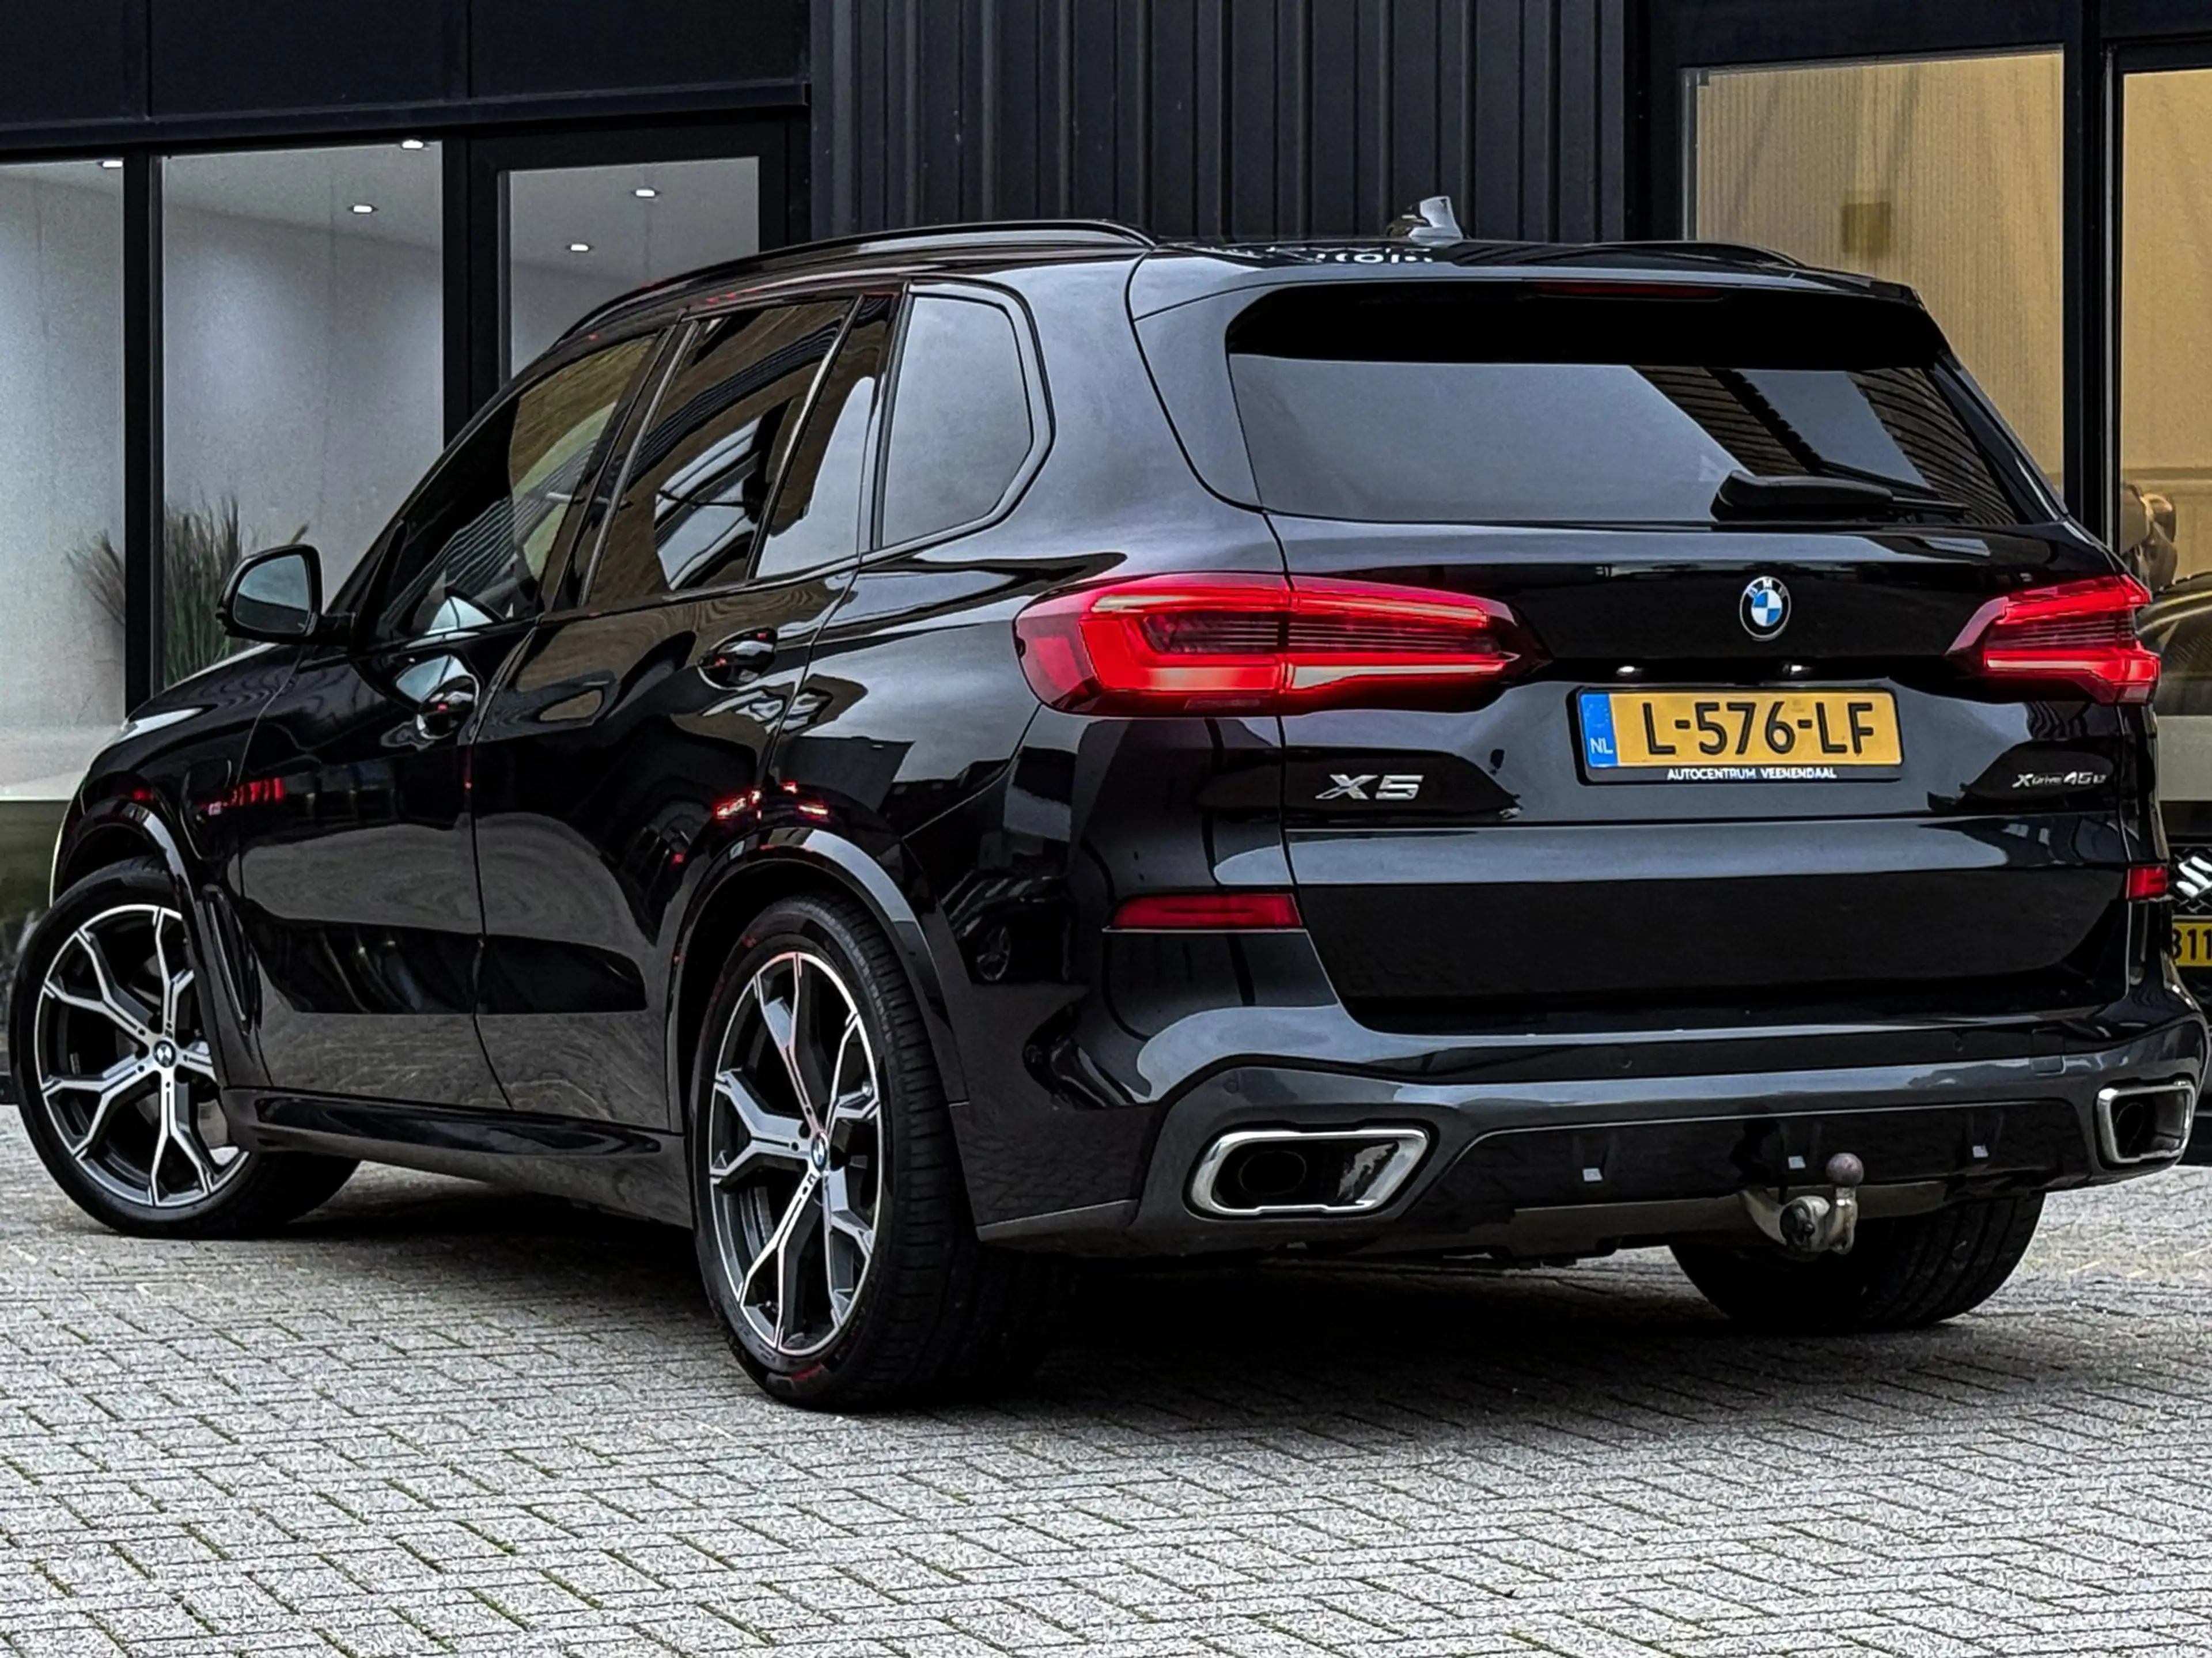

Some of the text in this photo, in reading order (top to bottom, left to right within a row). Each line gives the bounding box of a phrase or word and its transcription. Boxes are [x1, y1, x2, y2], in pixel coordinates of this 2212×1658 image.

[1642, 701, 1874, 755] L-576-LF
[1589, 737, 1613, 754] NL
[1667, 768, 1756, 780] AUTOCENTRUM
[1315, 774, 1425, 800] X5
